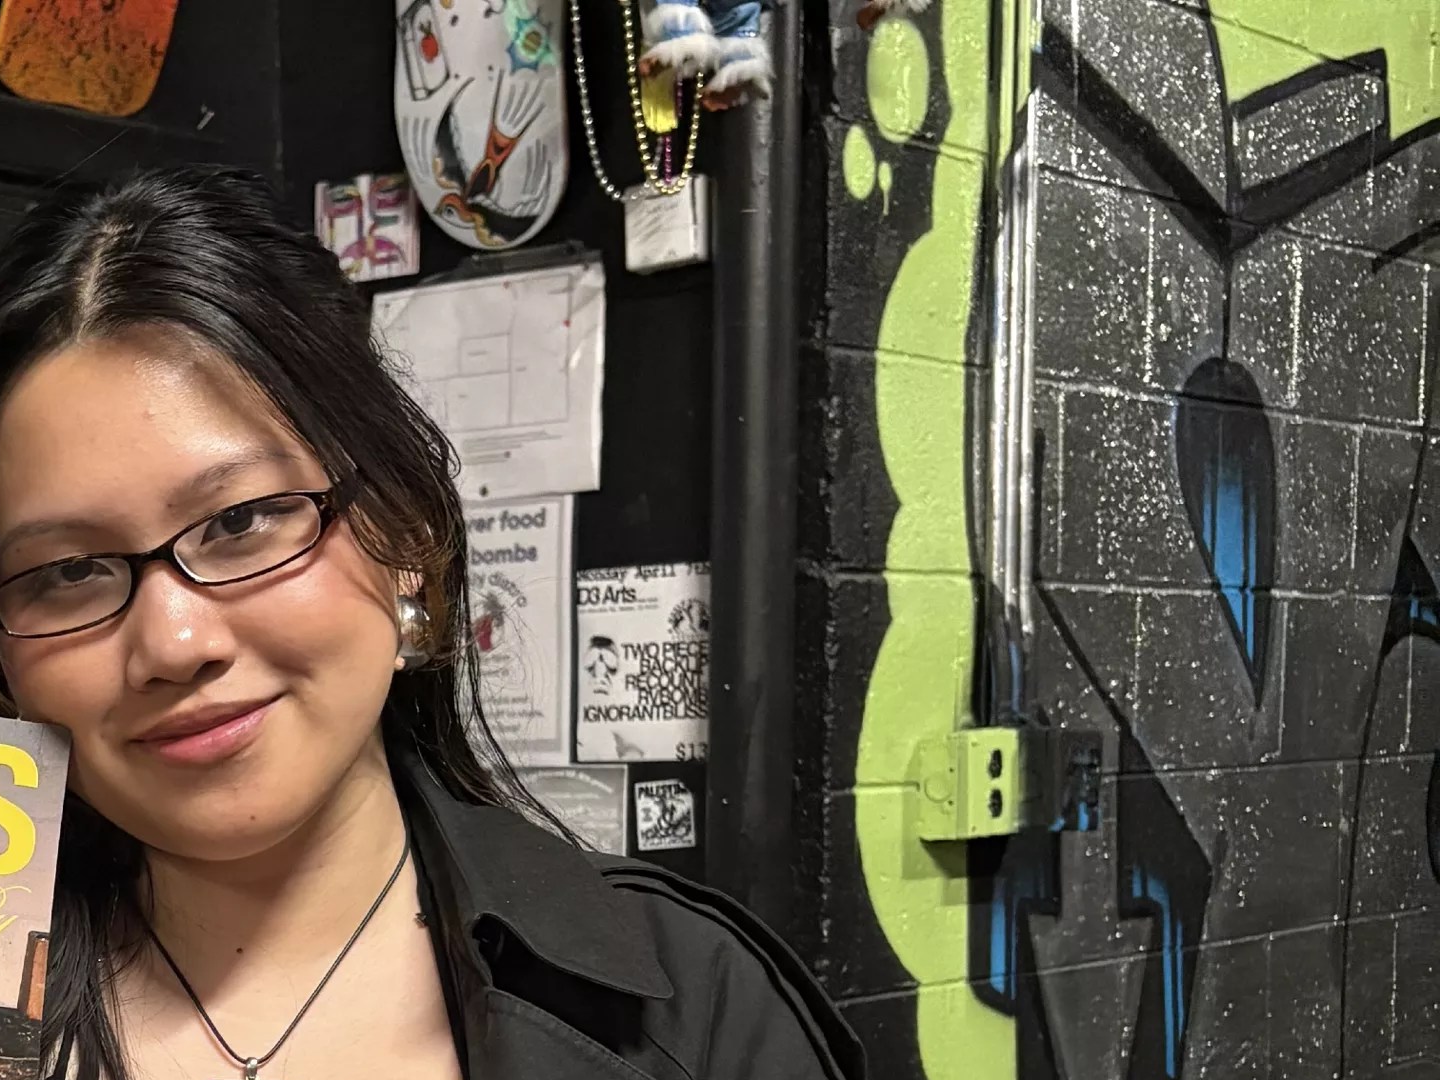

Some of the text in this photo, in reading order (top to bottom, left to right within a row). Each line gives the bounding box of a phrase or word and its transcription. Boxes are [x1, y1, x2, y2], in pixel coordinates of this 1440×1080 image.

[500, 507, 546, 532] food
[471, 543, 537, 565] bombs
[635, 565, 676, 581] April
[578, 587, 637, 605] D3 Arts
[621, 643, 660, 660] TWO
[625, 672, 703, 691] RECOUNT
